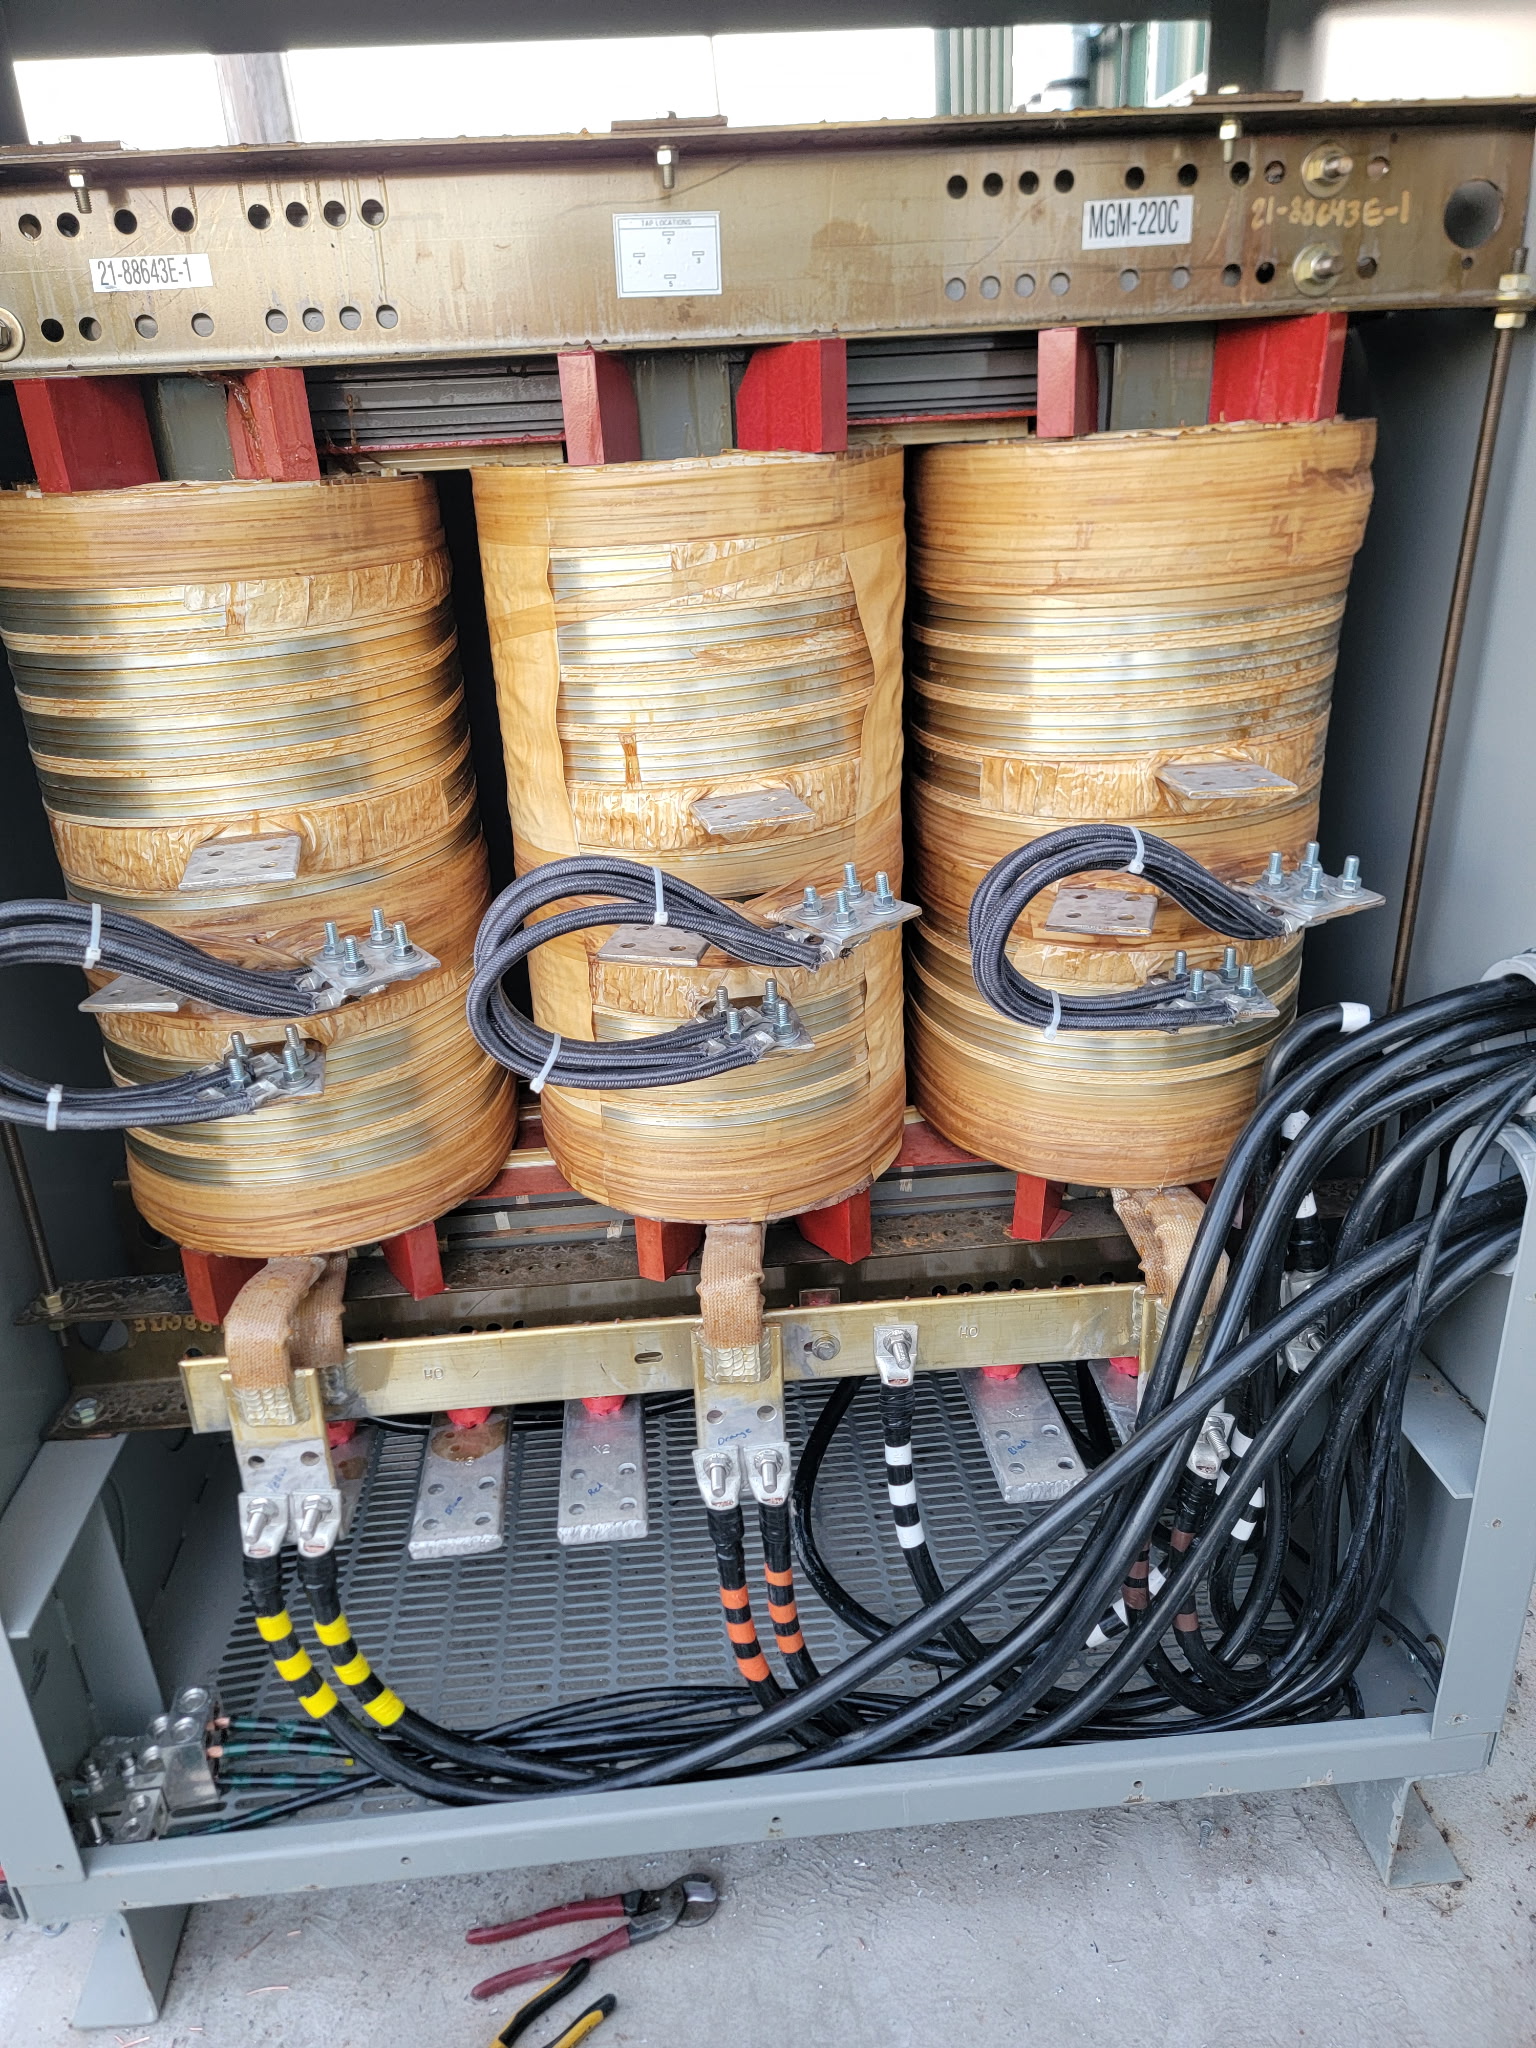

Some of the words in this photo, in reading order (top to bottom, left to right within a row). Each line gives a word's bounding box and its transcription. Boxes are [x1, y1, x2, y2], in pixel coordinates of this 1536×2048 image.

[641, 219, 654, 227] TAP
[655, 218, 692, 227] LOCATIONS
[1089, 199, 1179, 239] MGM-220C
[666, 237, 672, 245] 2
[97, 256, 192, 286] 21-88643E-1
[668, 280, 674, 288] 5
[717, 1428, 753, 1446] Orange
[1007, 1439, 1032, 1456] Black
